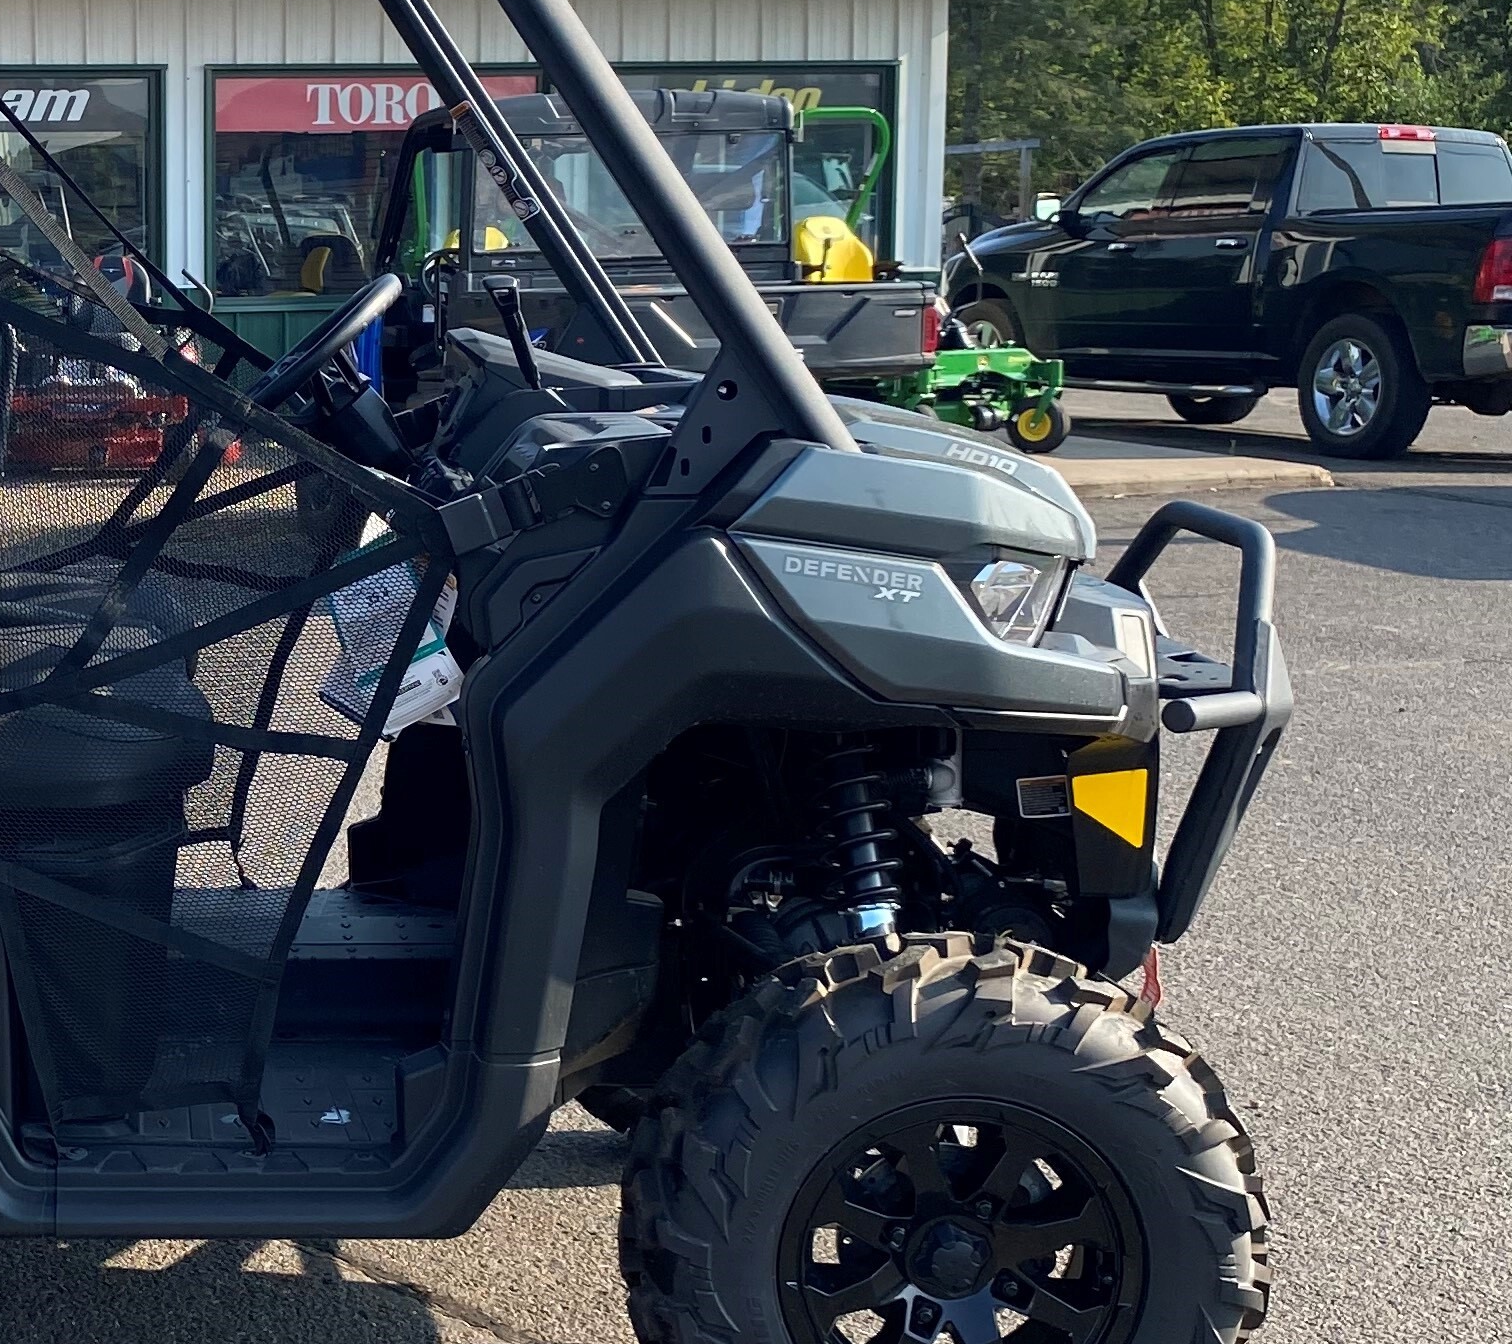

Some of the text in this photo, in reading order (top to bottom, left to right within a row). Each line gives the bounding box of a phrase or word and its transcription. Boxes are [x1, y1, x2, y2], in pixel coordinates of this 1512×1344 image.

[306, 83, 442, 125] TORO
[946, 443, 1019, 475] HD10
[785, 556, 923, 590] DEFENDER
[874, 587, 921, 603] XT
